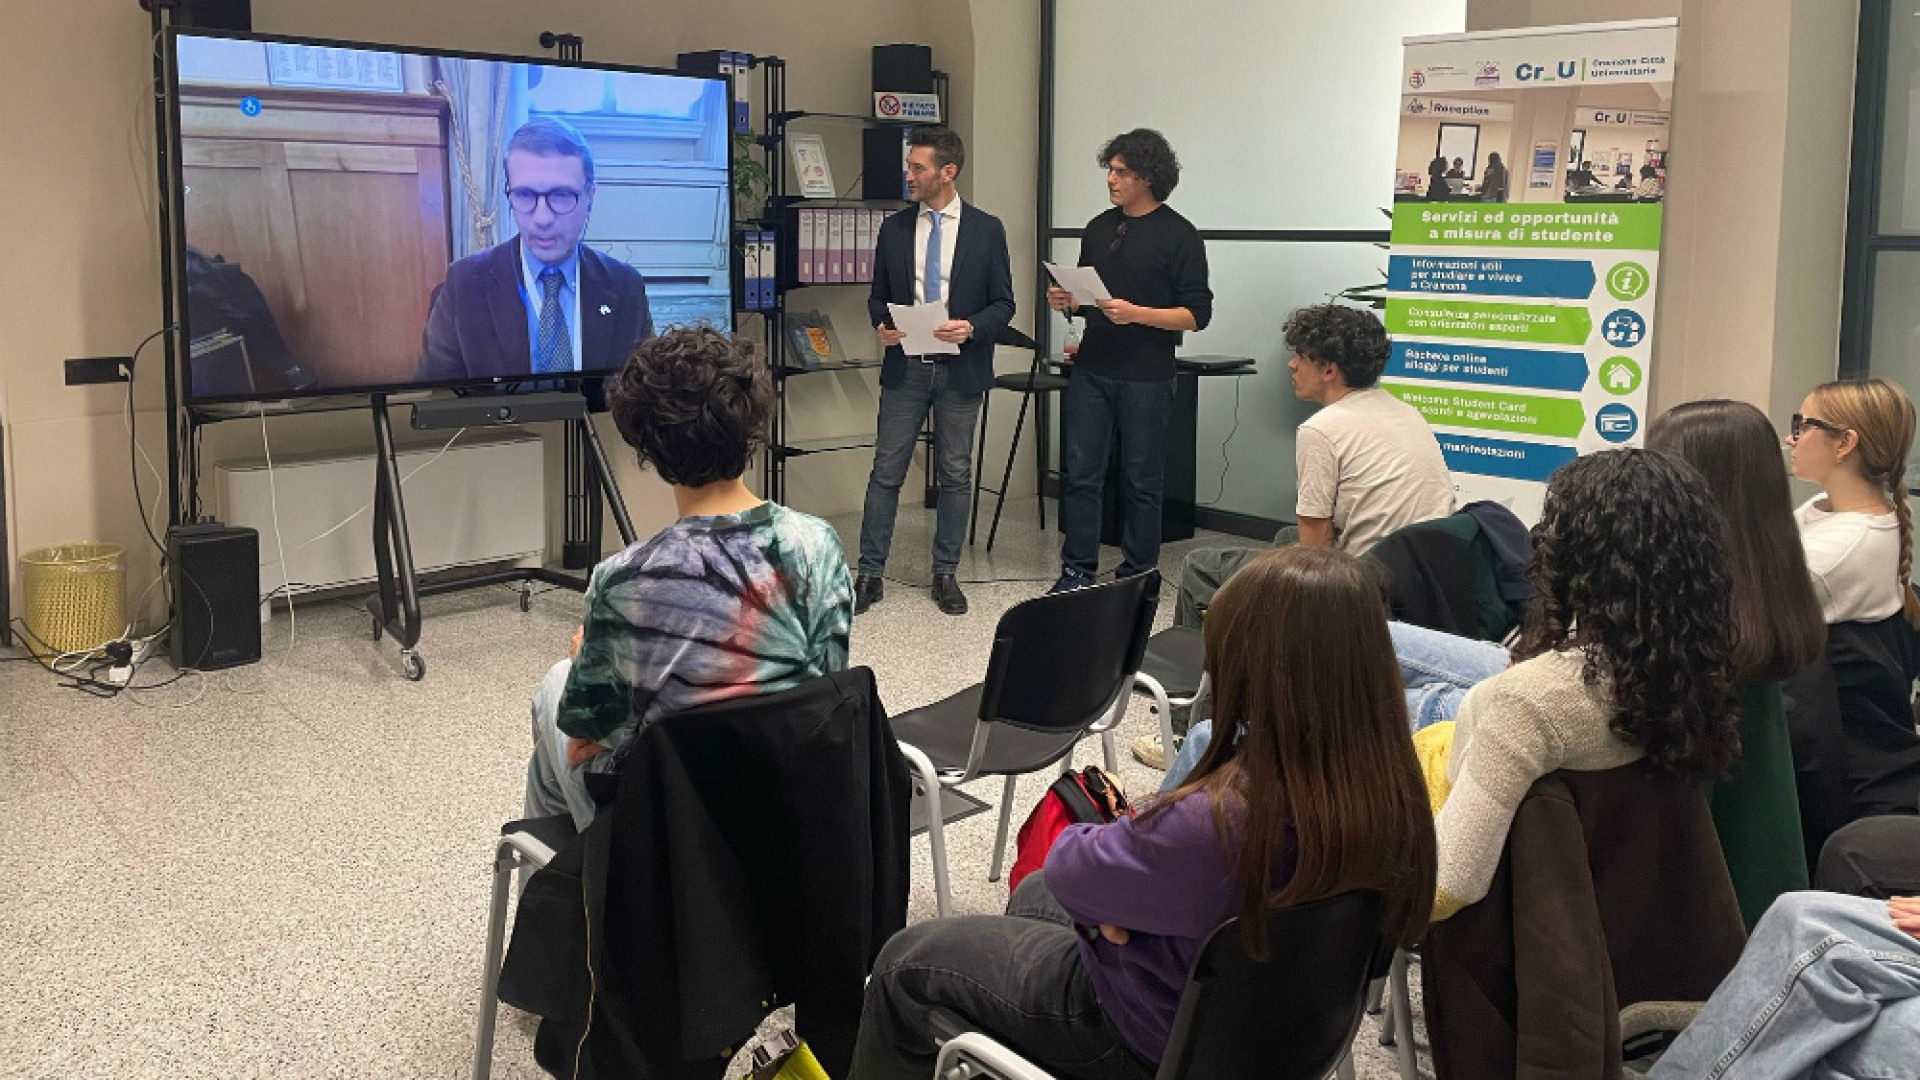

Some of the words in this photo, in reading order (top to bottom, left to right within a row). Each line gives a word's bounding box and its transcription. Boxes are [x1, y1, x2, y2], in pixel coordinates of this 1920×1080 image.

[1515, 61, 1576, 81] Cr_U
[1433, 103, 1490, 115] Reception
[1422, 210, 1478, 223] Servizi
[1483, 210, 1504, 224] ed
[1510, 211, 1619, 226] opportunità
[1429, 229, 1439, 239] a
[1443, 227, 1502, 240] misura
[1508, 228, 1525, 240] di
[1531, 229, 1614, 242] studente
[1412, 258, 1478, 270] Informazioni
[1481, 260, 1502, 271] utili
[1410, 271, 1429, 281] per
[1431, 270, 1474, 281] studiare
[1477, 273, 1485, 281] e
[1488, 272, 1524, 283] vivere
[1410, 281, 1418, 289] a
[1420, 279, 1467, 291] Cremona
[1408, 306, 1470, 319] Consulenza
[1472, 310, 1556, 323] personalizzate
[1408, 318, 1428, 328] con
[1489, 322, 1529, 333] esperti
[1404, 348, 1450, 361] Bacheca
[1453, 352, 1487, 364] online
[1404, 360, 1440, 373] alloggi
[1441, 363, 1460, 375] per
[1462, 364, 1508, 377] studenti
[1402, 392, 1449, 405] Welcome
[1452, 396, 1495, 409] Student
[1499, 400, 1527, 413] Card
[1456, 409, 1464, 417] e
[1467, 410, 1537, 424] agevolazioni
[1443, 442, 1526, 459] manifestazioni
